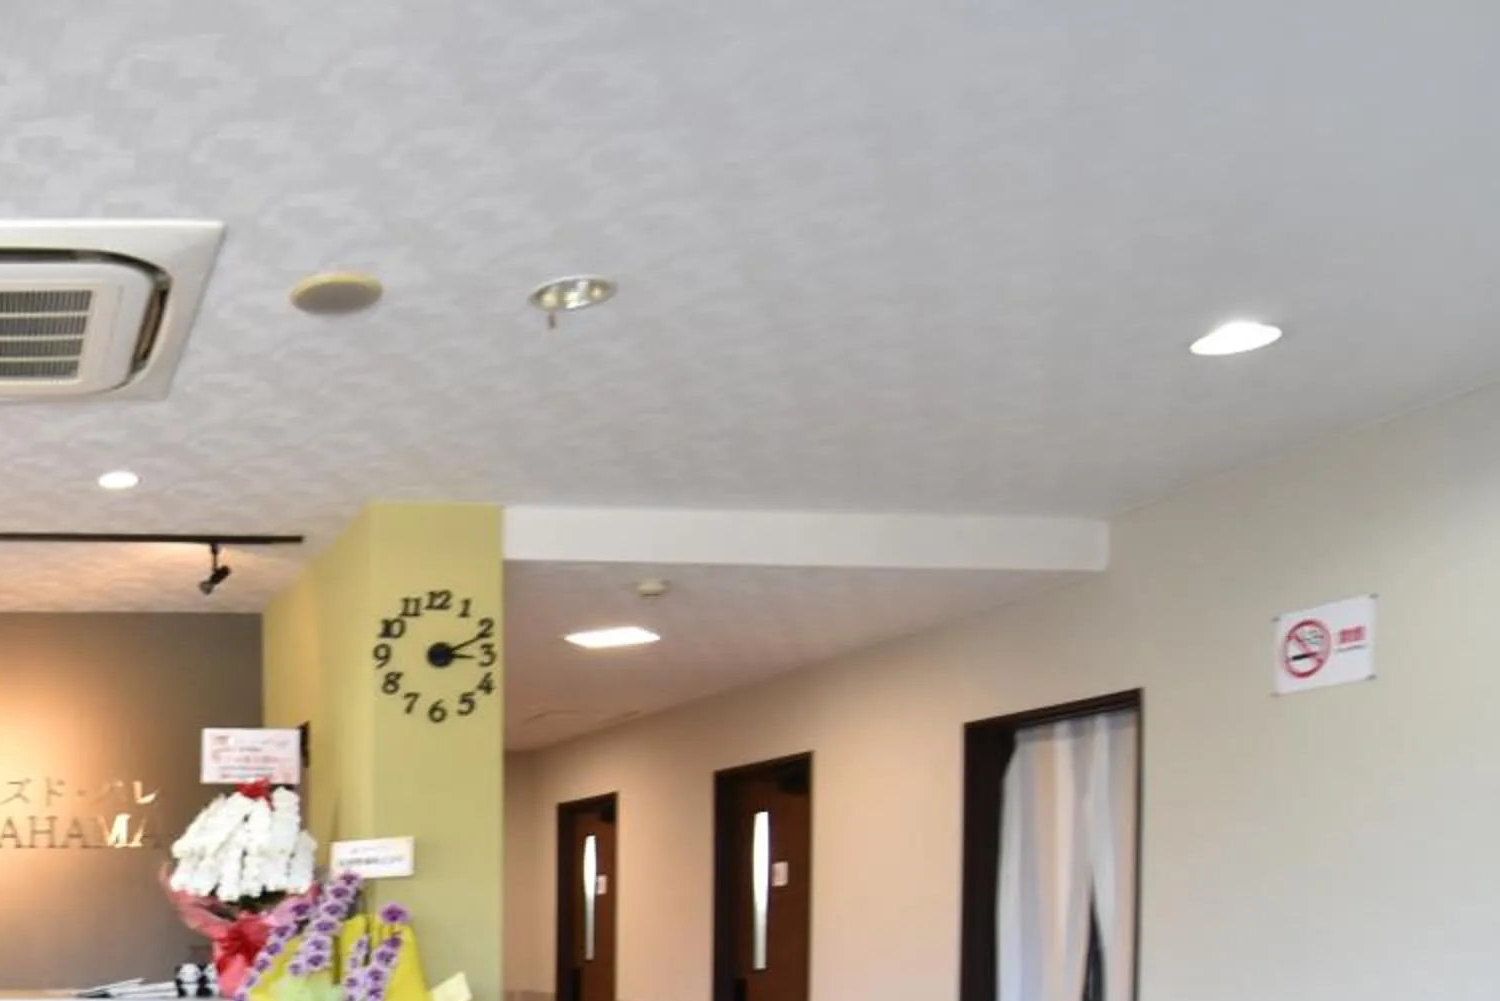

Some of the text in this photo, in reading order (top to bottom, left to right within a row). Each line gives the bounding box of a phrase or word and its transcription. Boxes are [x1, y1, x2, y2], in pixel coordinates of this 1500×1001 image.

[399, 597, 422, 617] 11
[425, 590, 453, 610] 12
[458, 598, 471, 618] 1
[378, 618, 406, 639] 10
[478, 617, 494, 638] 2
[373, 643, 392, 669] 9
[478, 643, 497, 667] 3
[381, 671, 403, 695] 8
[476, 672, 495, 694] 4
[403, 692, 420, 714] 7
[428, 699, 447, 723] 6
[457, 692, 476, 716] 5
